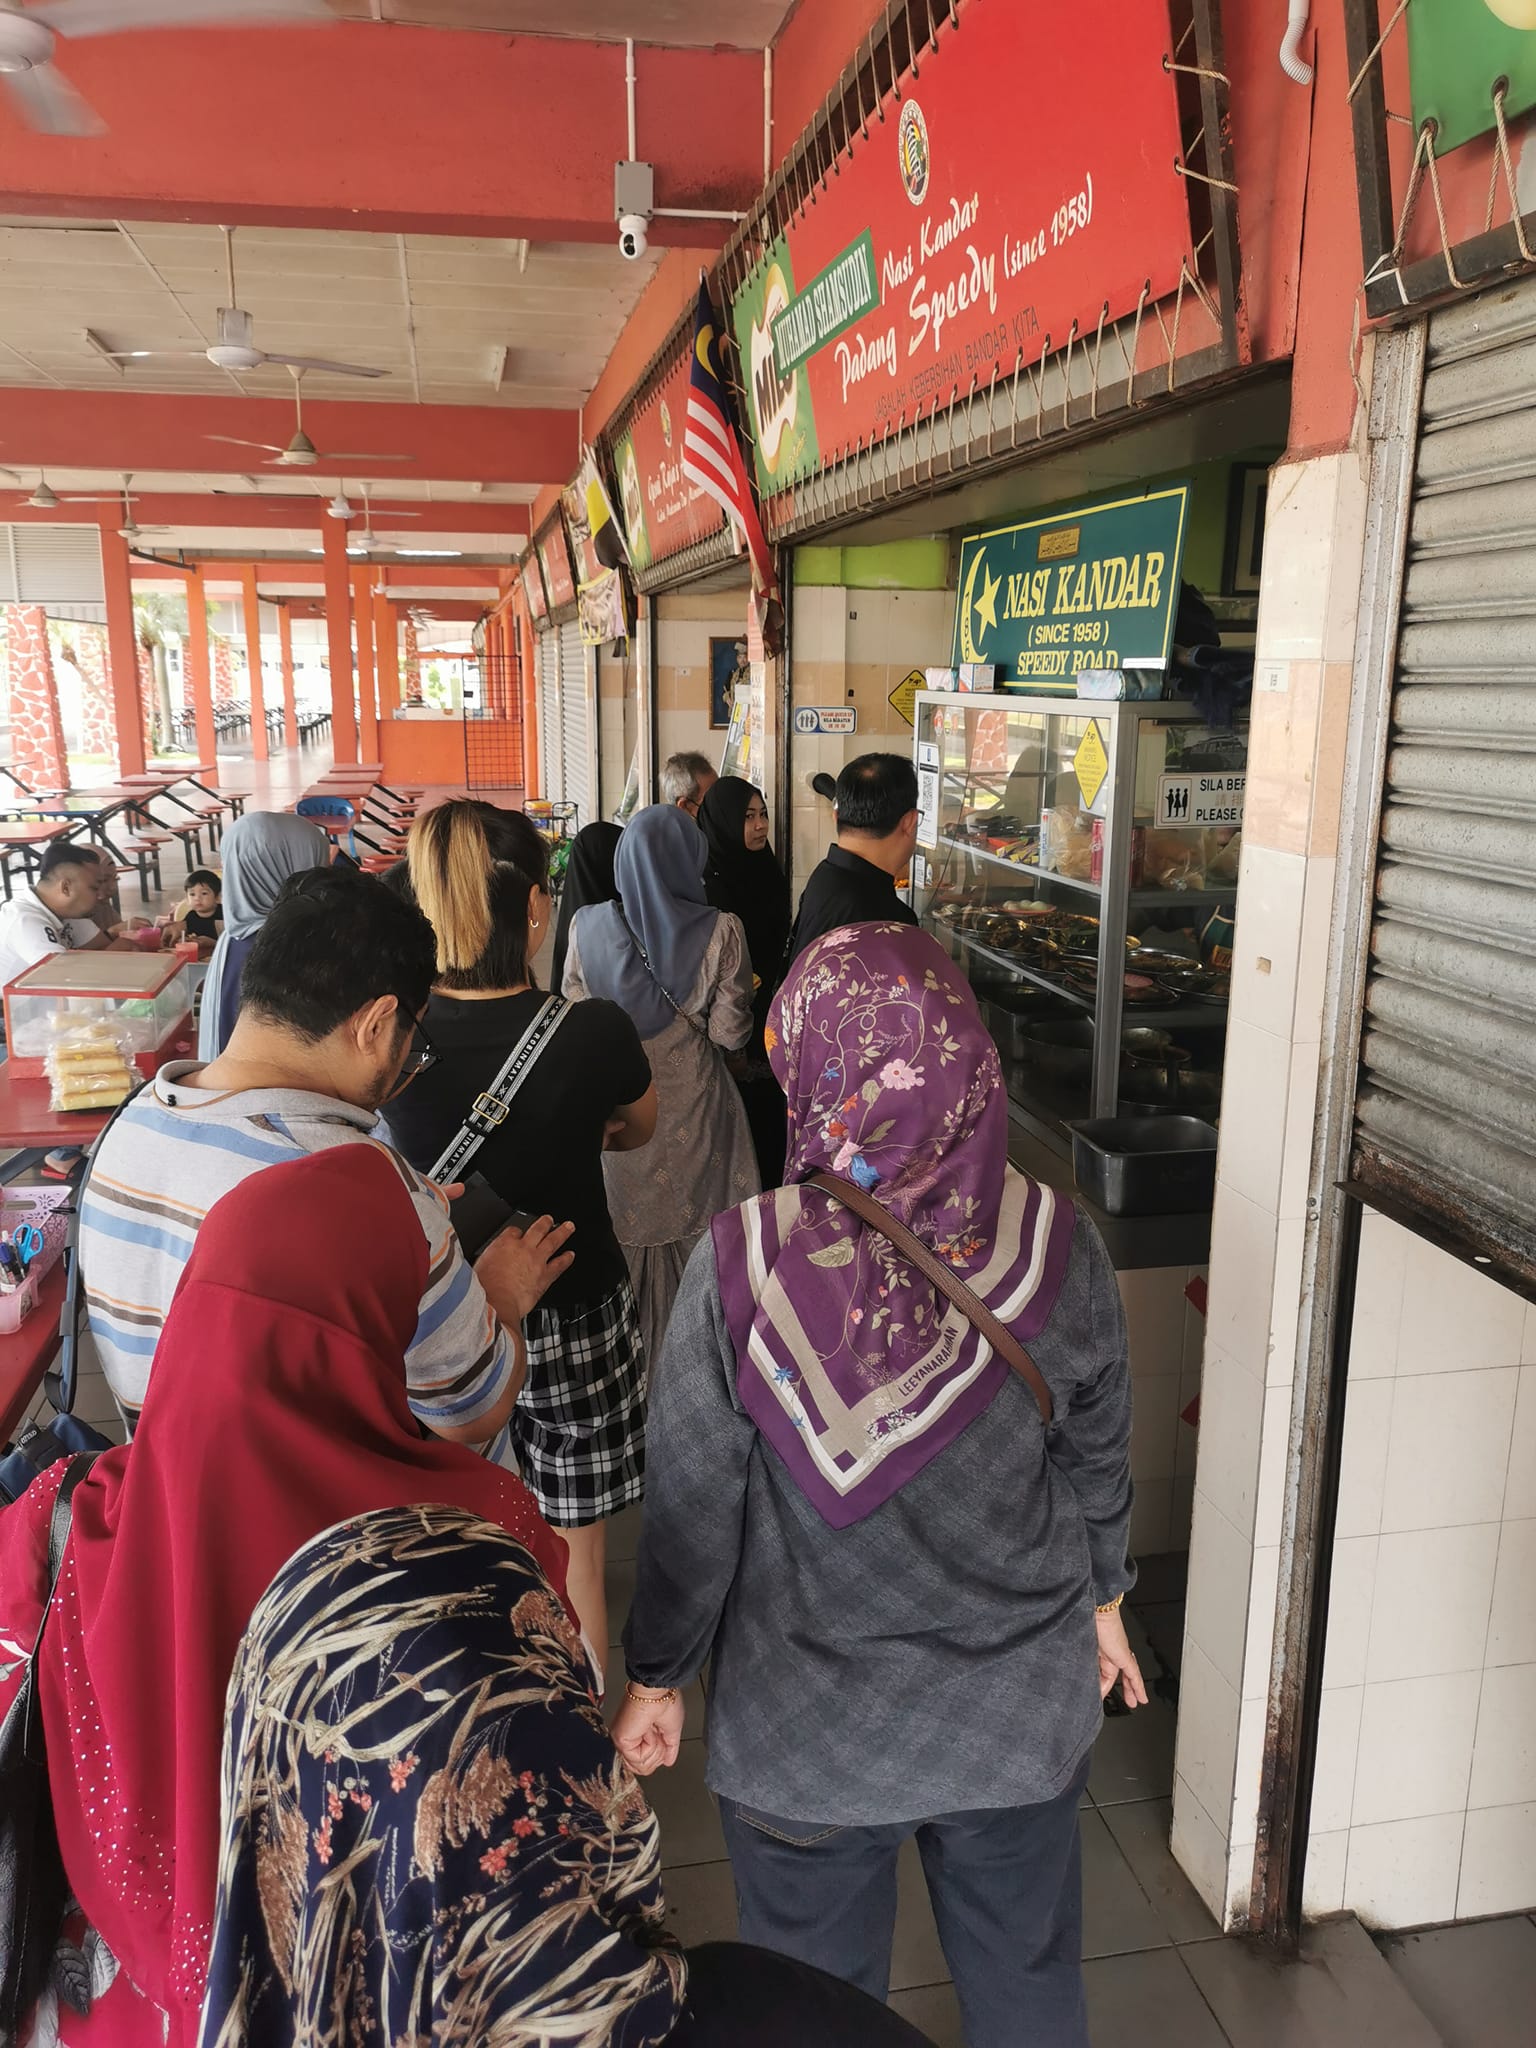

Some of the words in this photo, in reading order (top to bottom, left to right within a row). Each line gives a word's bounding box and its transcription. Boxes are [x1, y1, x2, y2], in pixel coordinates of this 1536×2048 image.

[881, 245, 914, 306] Nasi
[920, 191, 979, 265] Kandar
[774, 294, 817, 370] MUHAMAD
[813, 243, 872, 339] SHAMSUDIN
[834, 327, 897, 404] Padang
[908, 245, 997, 357] Speedy
[1003, 229, 1046, 280] (since
[1050, 172, 1093, 247] 1958)
[875, 391, 906, 421] JAGALAH
[909, 353, 963, 401] KEBERSIHAN
[965, 323, 1008, 369] BANDAR
[1012, 306, 1040, 341] KITA
[1002, 567, 1052, 620] NASI
[1052, 551, 1165, 616] KANDAR
[1016, 651, 1071, 676] SPEEDY
[1070, 650, 1118, 675] ROAD
[1195, 807, 1238, 821] PLEASE
[1199, 778, 1224, 791] SILA
[507, 1032, 541, 1082] ROBINMAY
[450, 1131, 477, 1164] BINMAY
